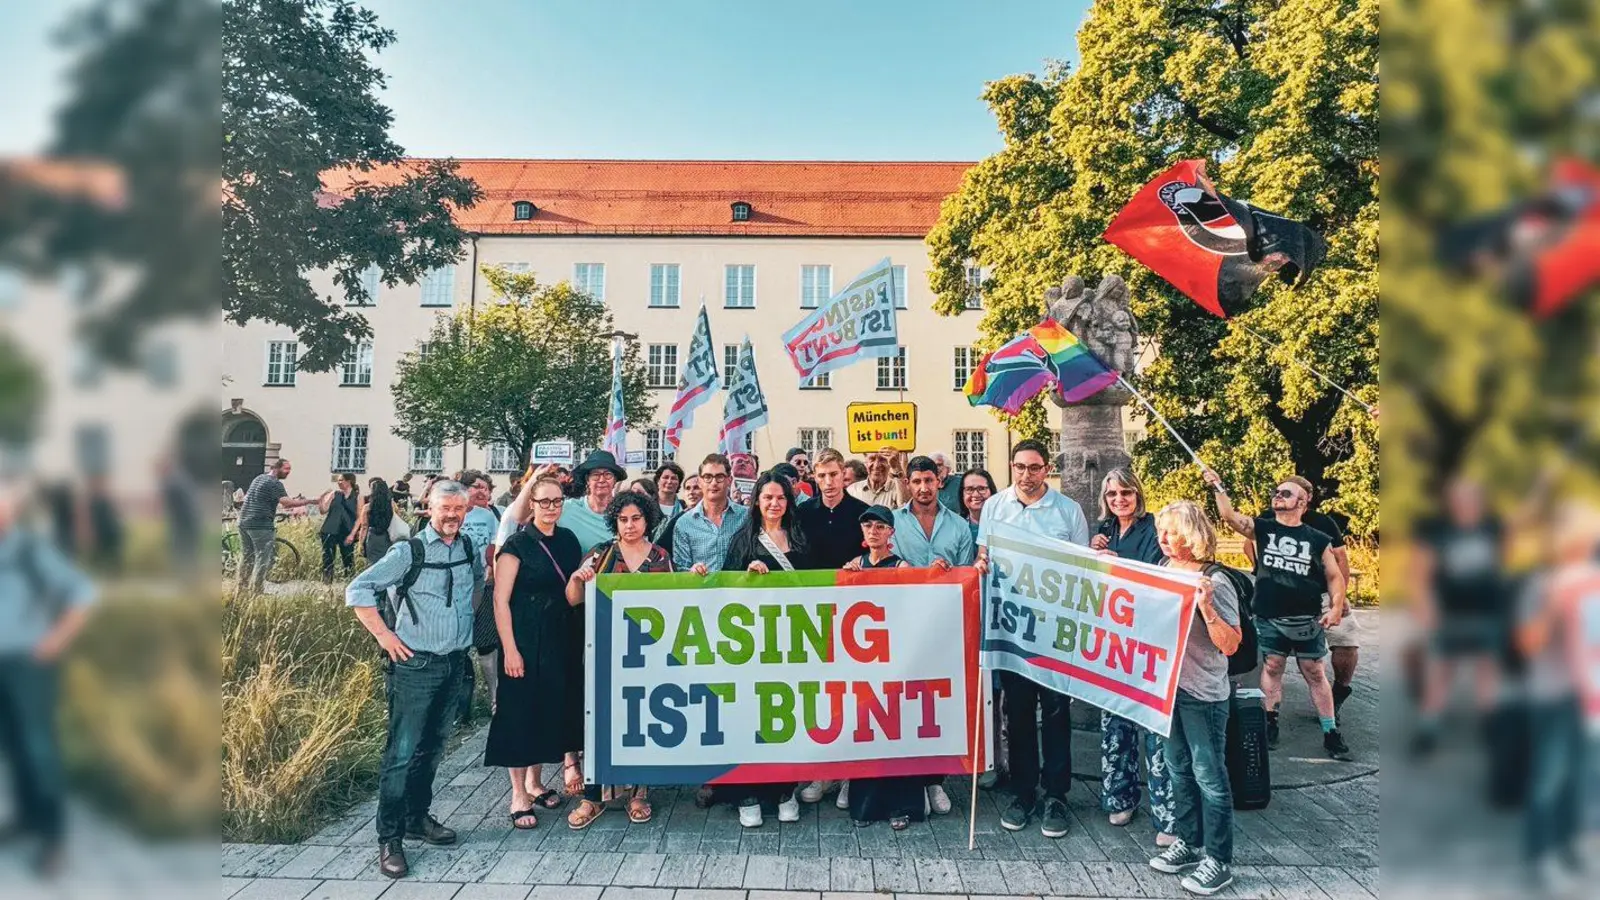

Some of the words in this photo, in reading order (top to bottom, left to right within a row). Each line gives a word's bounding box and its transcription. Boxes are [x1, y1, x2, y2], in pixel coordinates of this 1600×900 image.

[853, 410, 909, 423] München
[857, 430, 872, 441] ist
[875, 429, 907, 441] bunt!
[1263, 554, 1311, 576] CREW
[1267, 533, 1311, 560] 161
[991, 556, 1135, 628] PASING
[622, 601, 890, 668] PASING
[990, 596, 1045, 642] IST
[1053, 615, 1168, 683] BUNT
[622, 682, 736, 748] IST
[754, 678, 952, 745] BUNT
